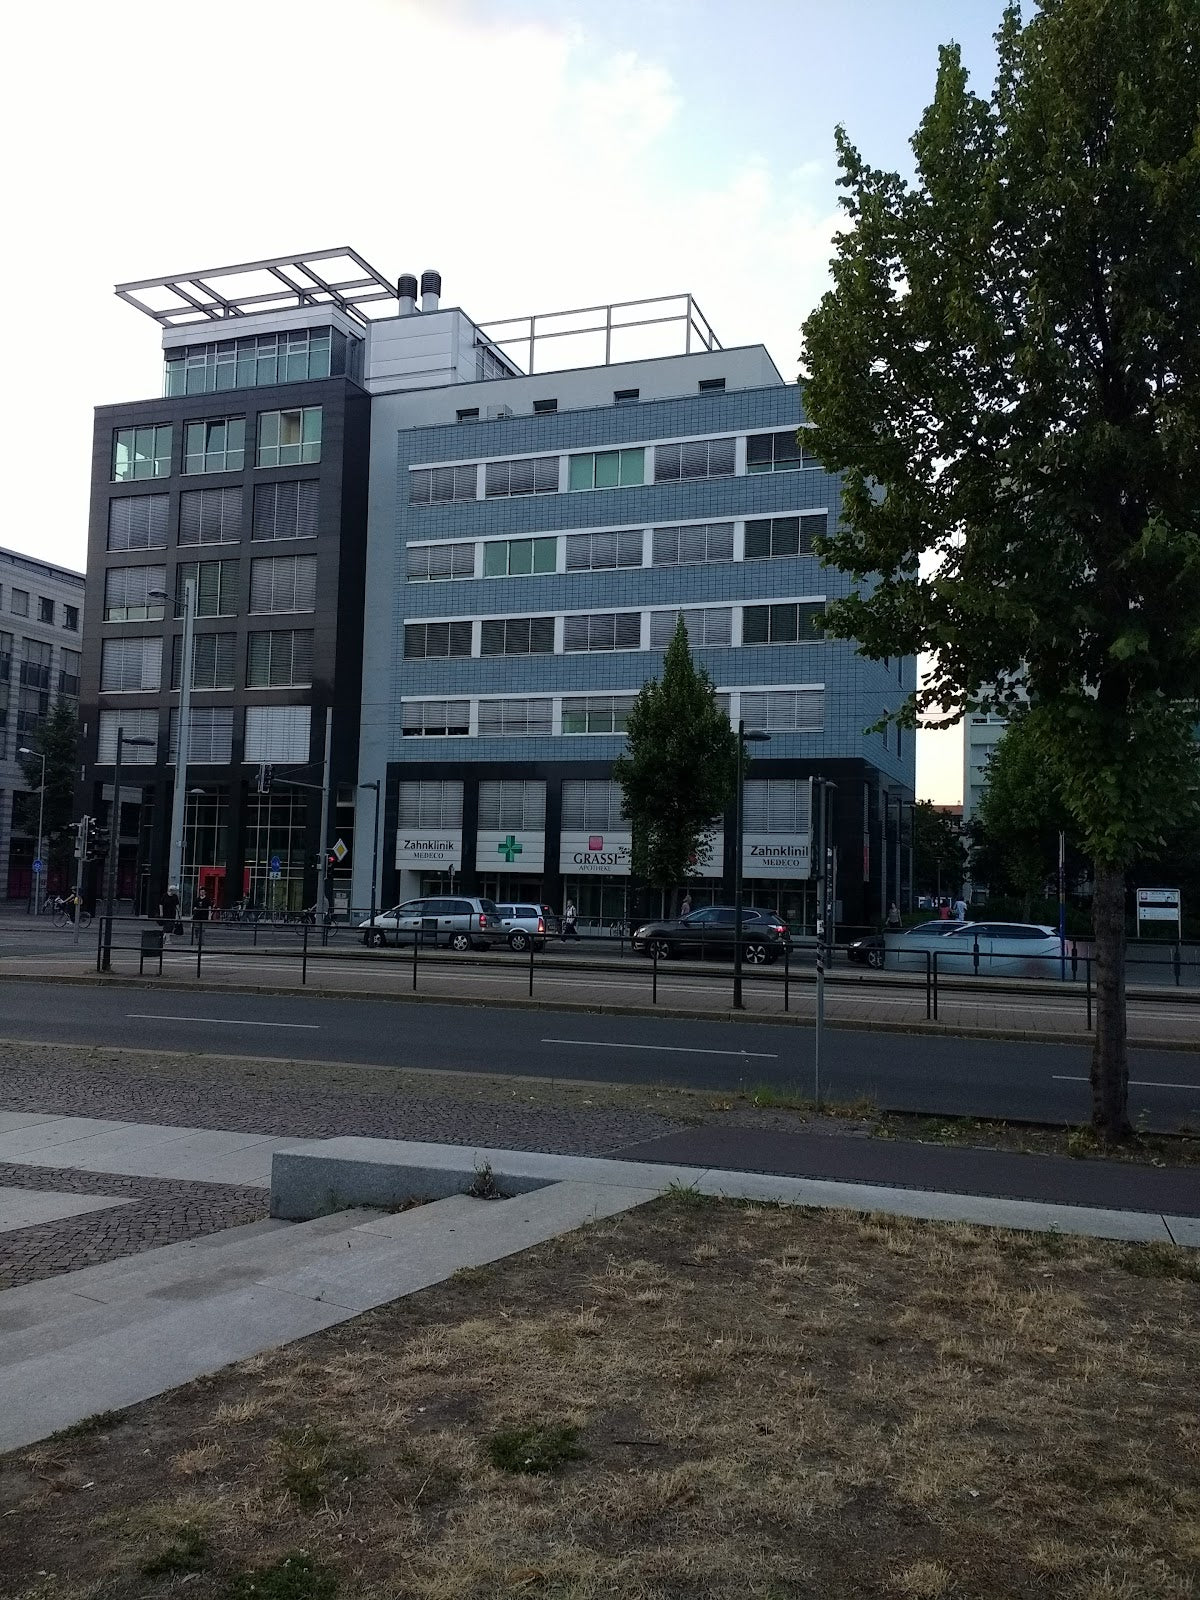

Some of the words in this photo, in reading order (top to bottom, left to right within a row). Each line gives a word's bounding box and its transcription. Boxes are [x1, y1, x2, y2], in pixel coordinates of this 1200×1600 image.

[404, 840, 454, 850] Zahnklinik
[573, 853, 618, 865] GRASSI
[763, 858, 800, 866] MEDECO
